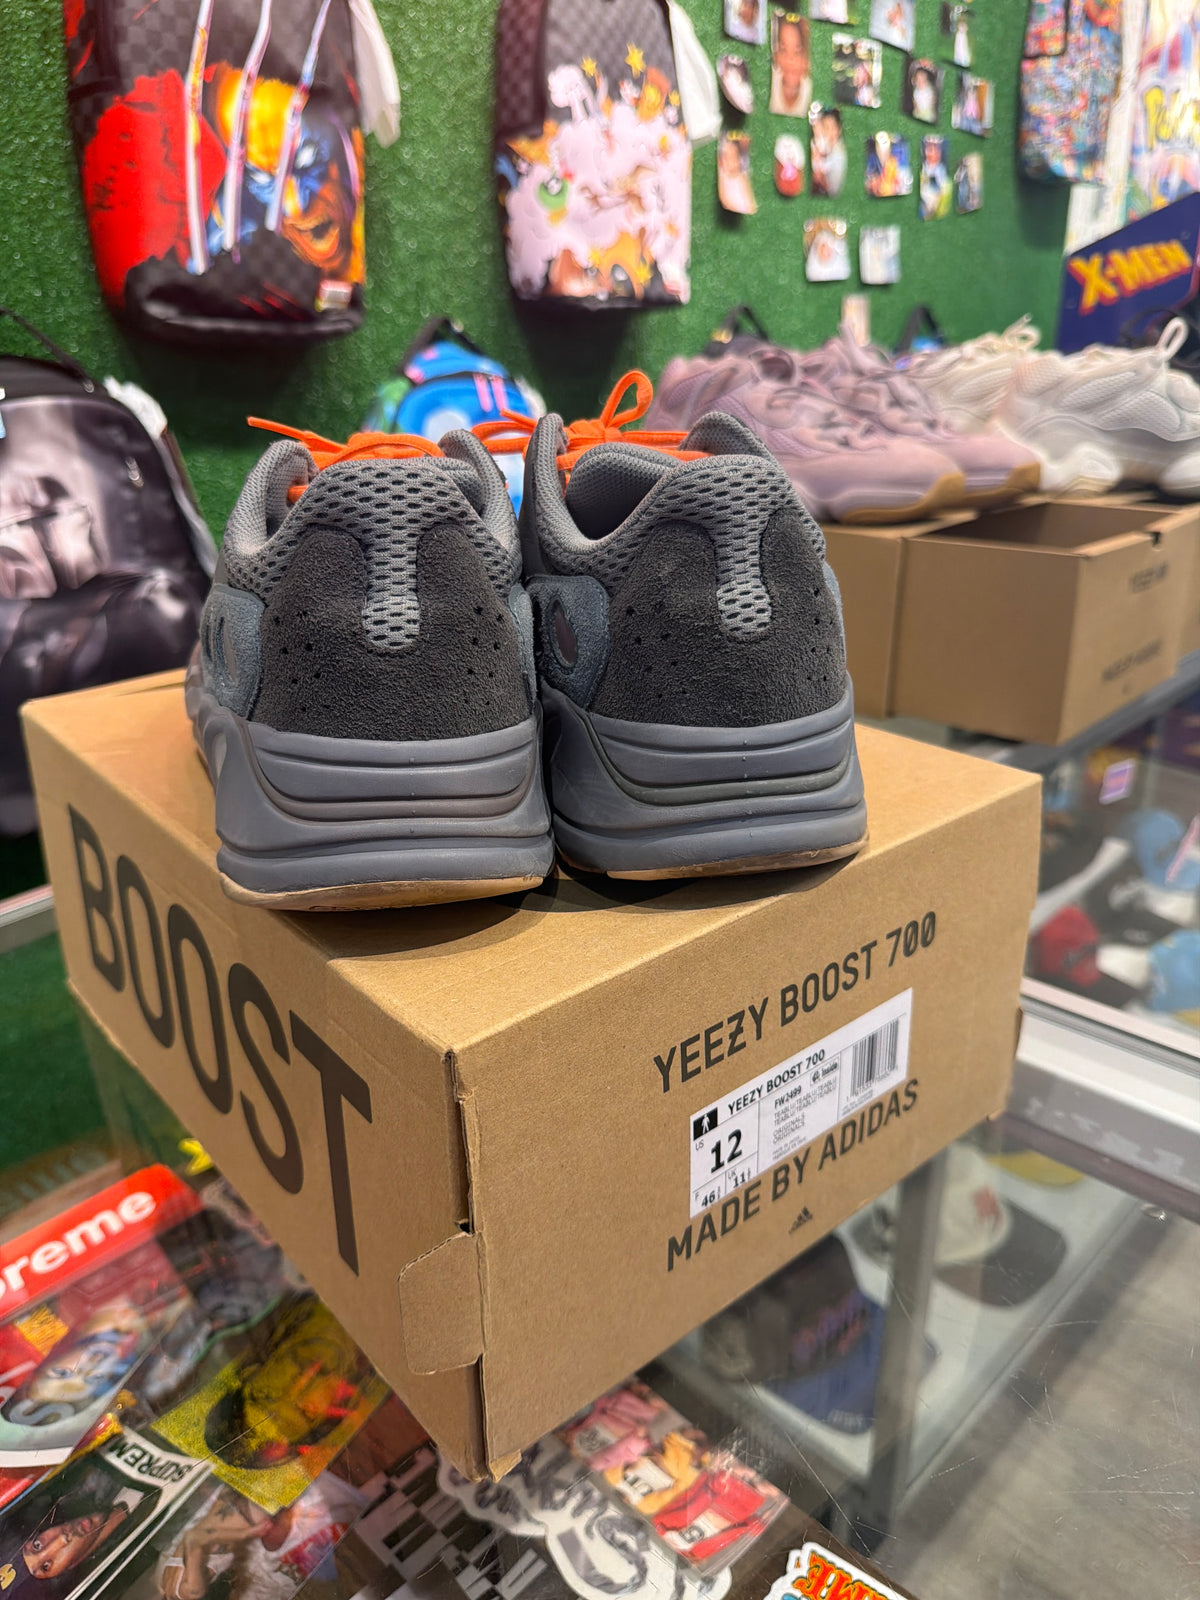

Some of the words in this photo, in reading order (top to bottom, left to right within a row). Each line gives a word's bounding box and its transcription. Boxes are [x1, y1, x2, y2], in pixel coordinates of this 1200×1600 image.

[1067, 239, 1192, 316] X-MEN
[68, 803, 373, 1277] BOOST
[653, 996, 769, 1093] YEEZY
[780, 940, 877, 1027] BOOST
[886, 911, 936, 967] 700
[728, 1085, 763, 1116] YEEZY
[766, 1061, 803, 1093] BOOST
[805, 1048, 826, 1070] 700
[667, 1180, 762, 1272] MADE
[771, 1147, 812, 1202] BY
[818, 1078, 919, 1171] ADIDAS
[695, 1139, 704, 1151] US
[710, 1128, 743, 1174] 12
[0, 1191, 156, 1300] reme
